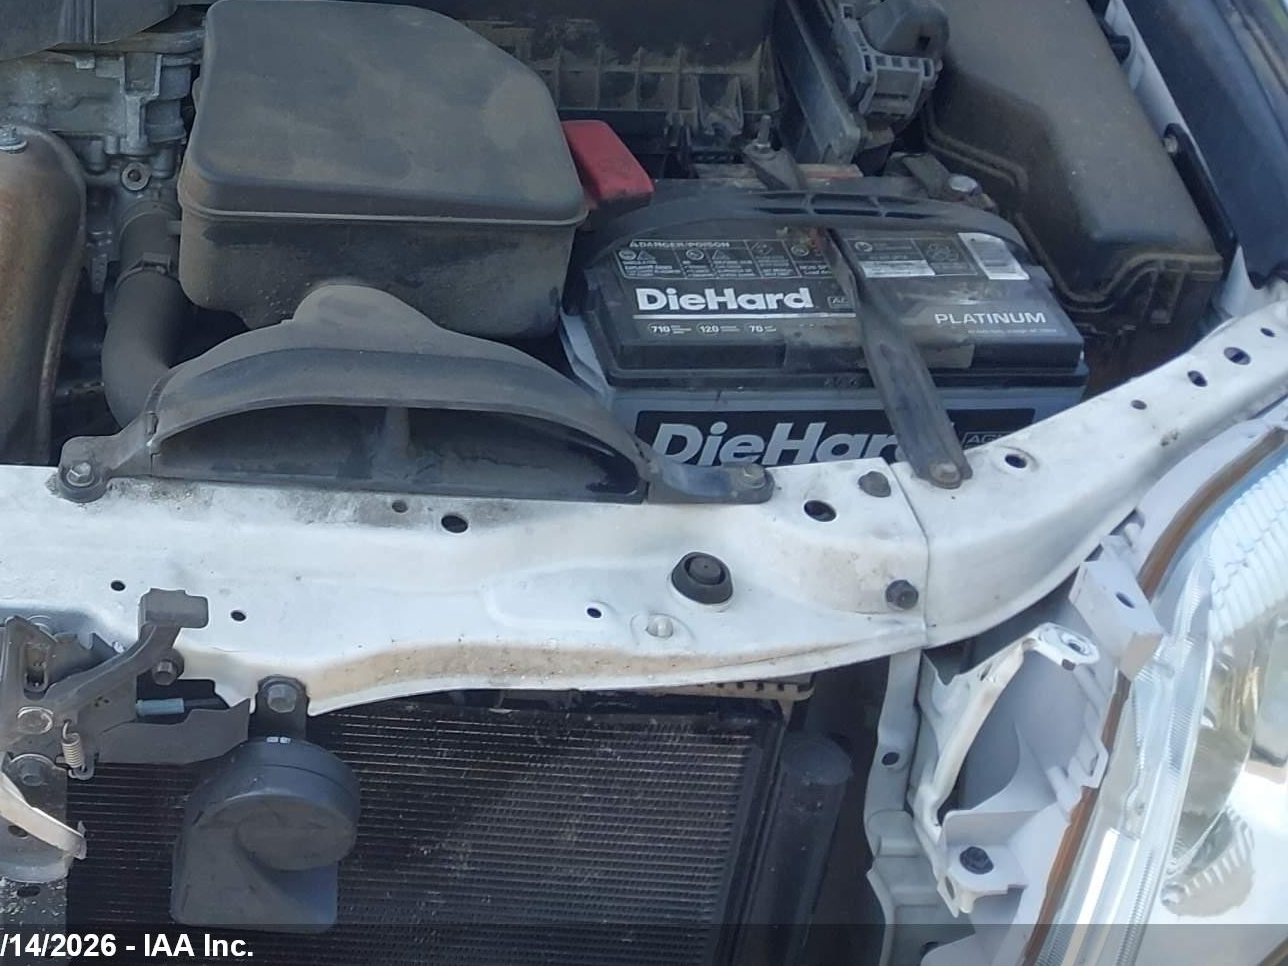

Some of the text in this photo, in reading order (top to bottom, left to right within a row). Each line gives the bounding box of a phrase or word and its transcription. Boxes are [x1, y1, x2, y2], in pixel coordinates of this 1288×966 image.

[635, 287, 814, 311] DieHard
[935, 312, 1047, 325] PLATINUM
[651, 324, 671, 334] 710
[699, 324, 719, 334] 120
[748, 324, 764, 334] 70
[651, 421, 905, 466] DieHar
